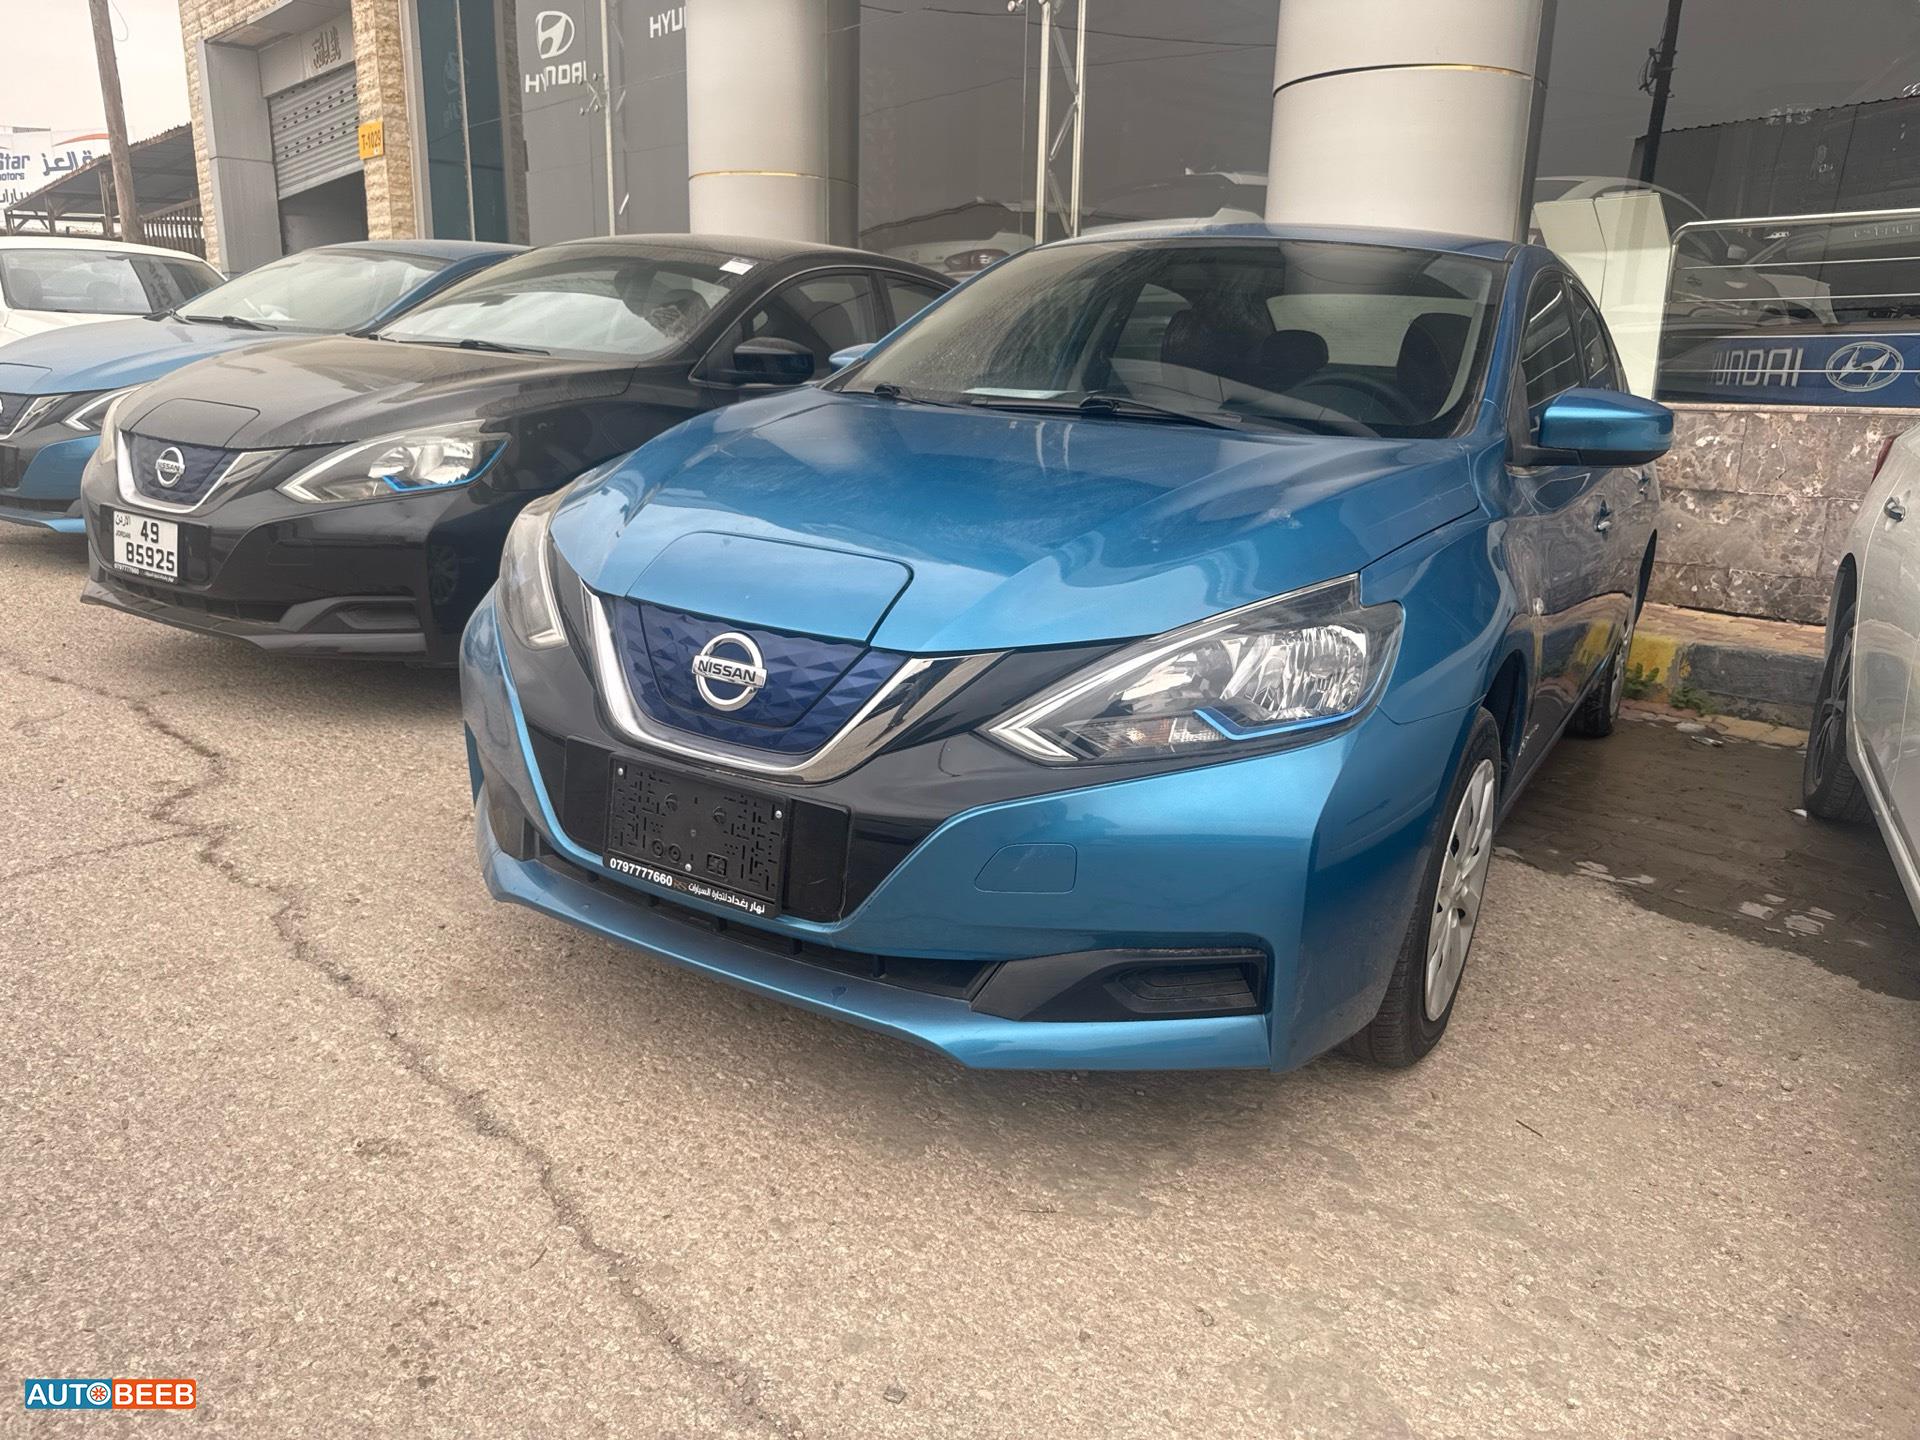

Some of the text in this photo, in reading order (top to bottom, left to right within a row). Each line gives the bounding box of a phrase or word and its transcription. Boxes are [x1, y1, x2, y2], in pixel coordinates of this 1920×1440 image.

[649, 6, 687, 39] HYU
[140, 520, 159, 543] 49
[126, 542, 175, 572] 85925
[697, 659, 757, 683] NISSAN
[609, 857, 673, 886] 0797777660
[727, 894, 749, 911] بغداد
[749, 900, 766, 915] نهار
